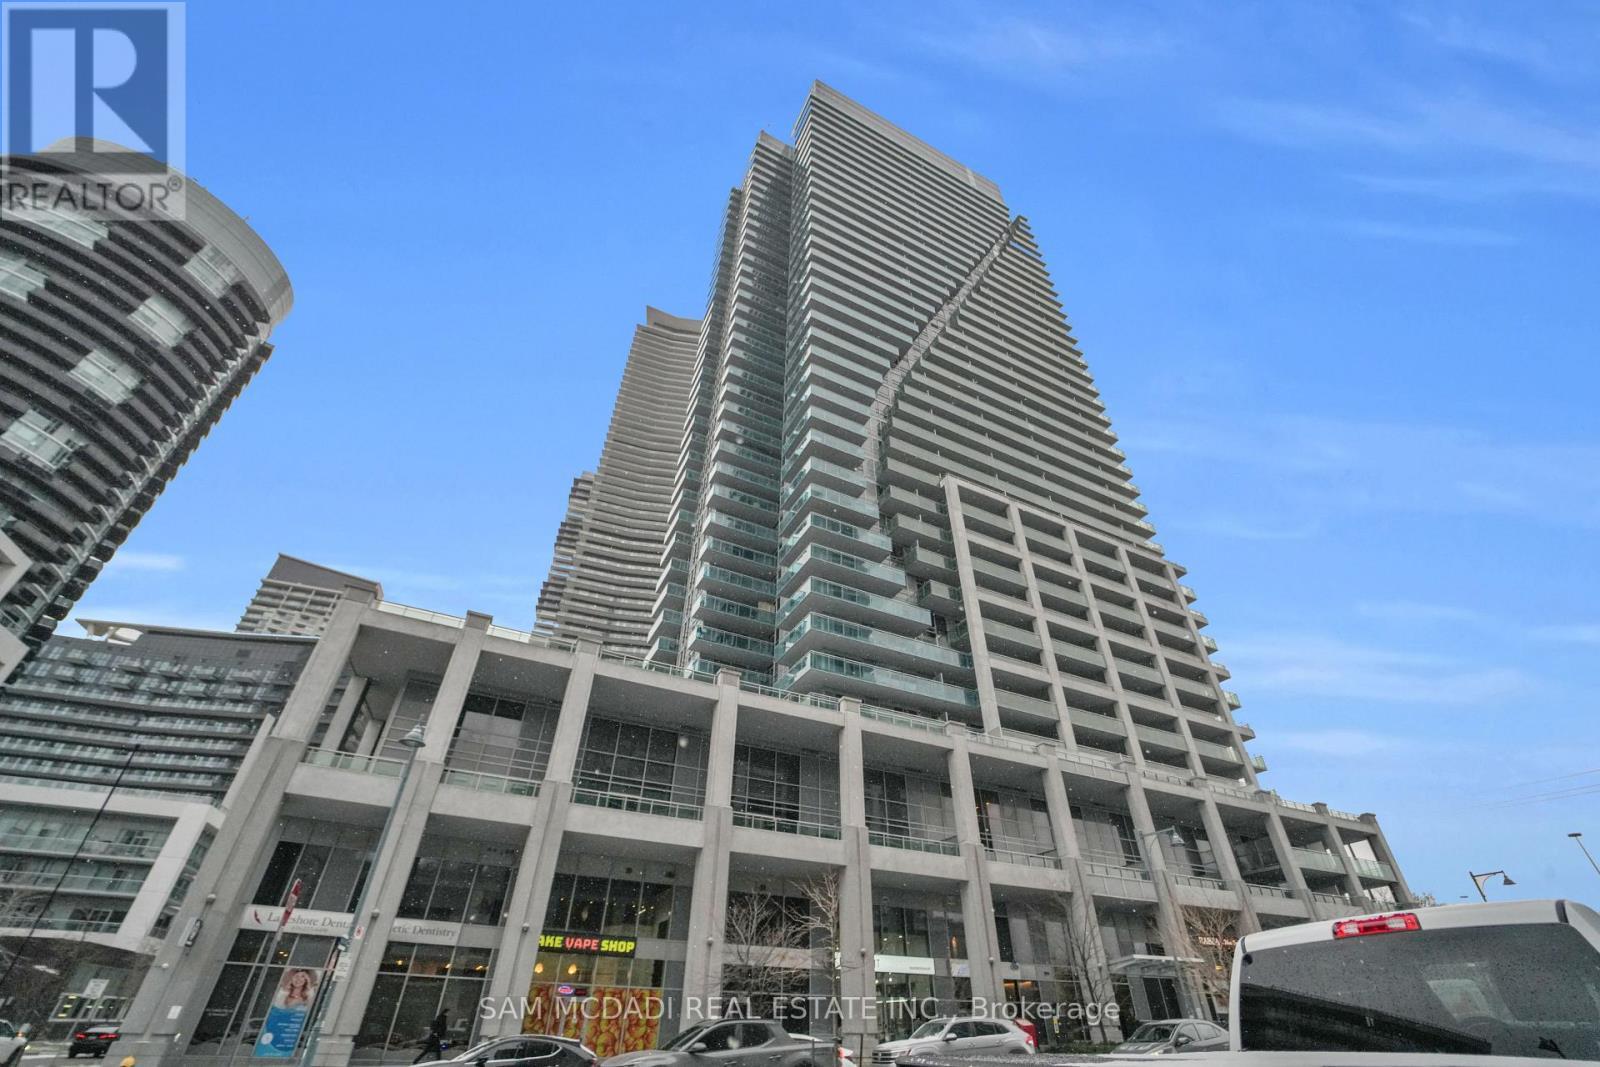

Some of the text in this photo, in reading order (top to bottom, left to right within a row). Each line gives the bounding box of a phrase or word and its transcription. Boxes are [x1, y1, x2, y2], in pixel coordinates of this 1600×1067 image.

[267, 911, 319, 927] Lashore
[321, 916, 351, 930] Dent
[391, 925, 456, 941] etic Dentistry
[538, 934, 635, 953] AKE VAPE SHOP
